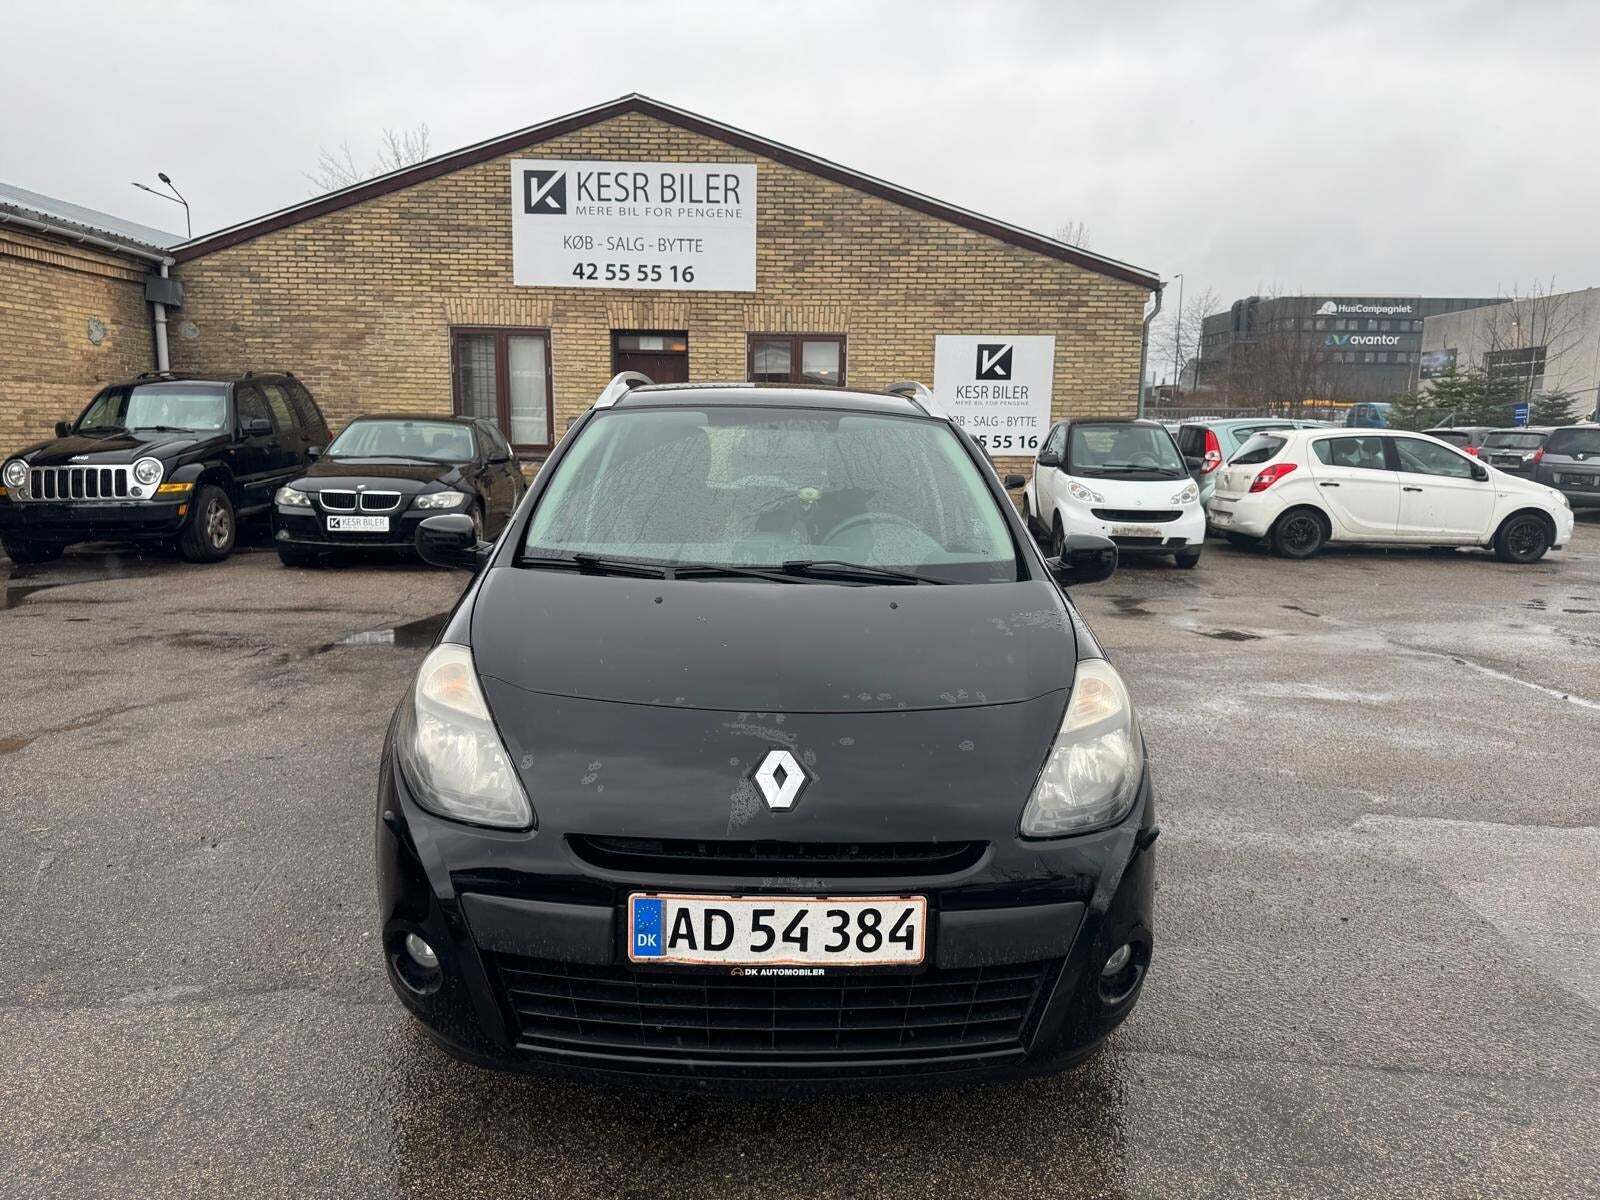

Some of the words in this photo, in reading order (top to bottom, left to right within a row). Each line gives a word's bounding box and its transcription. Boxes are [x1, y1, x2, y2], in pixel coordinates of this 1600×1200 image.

[577, 171, 650, 203] KESR
[661, 173, 741, 204] BILER
[576, 206, 613, 216] MERE
[619, 207, 639, 217] BIL
[646, 208, 672, 217] FOR
[678, 208, 742, 218] PENGENE
[563, 234, 593, 250] KØB
[607, 236, 645, 252] SALG
[658, 238, 703, 253] BYTTE
[572, 263, 598, 280] 42
[605, 263, 630, 281] 55
[637, 264, 662, 282] 55
[670, 265, 695, 283] 16
[1338, 304, 1412, 315] HusCompagniet
[1350, 334, 1400, 345] avantor
[956, 385, 989, 399] KESR
[993, 385, 1029, 400] BILER
[973, 416, 999, 427] SALG
[1007, 416, 1037, 427] BYTTE
[992, 435, 1013, 448] 55
[1019, 435, 1038, 448] 16
[342, 517, 362, 527] KESR
[363, 517, 384, 527] BILER
[668, 907, 735, 952] AD
[750, 908, 809, 953] 54
[824, 907, 915, 954] 384
[637, 933, 657, 948] DK
